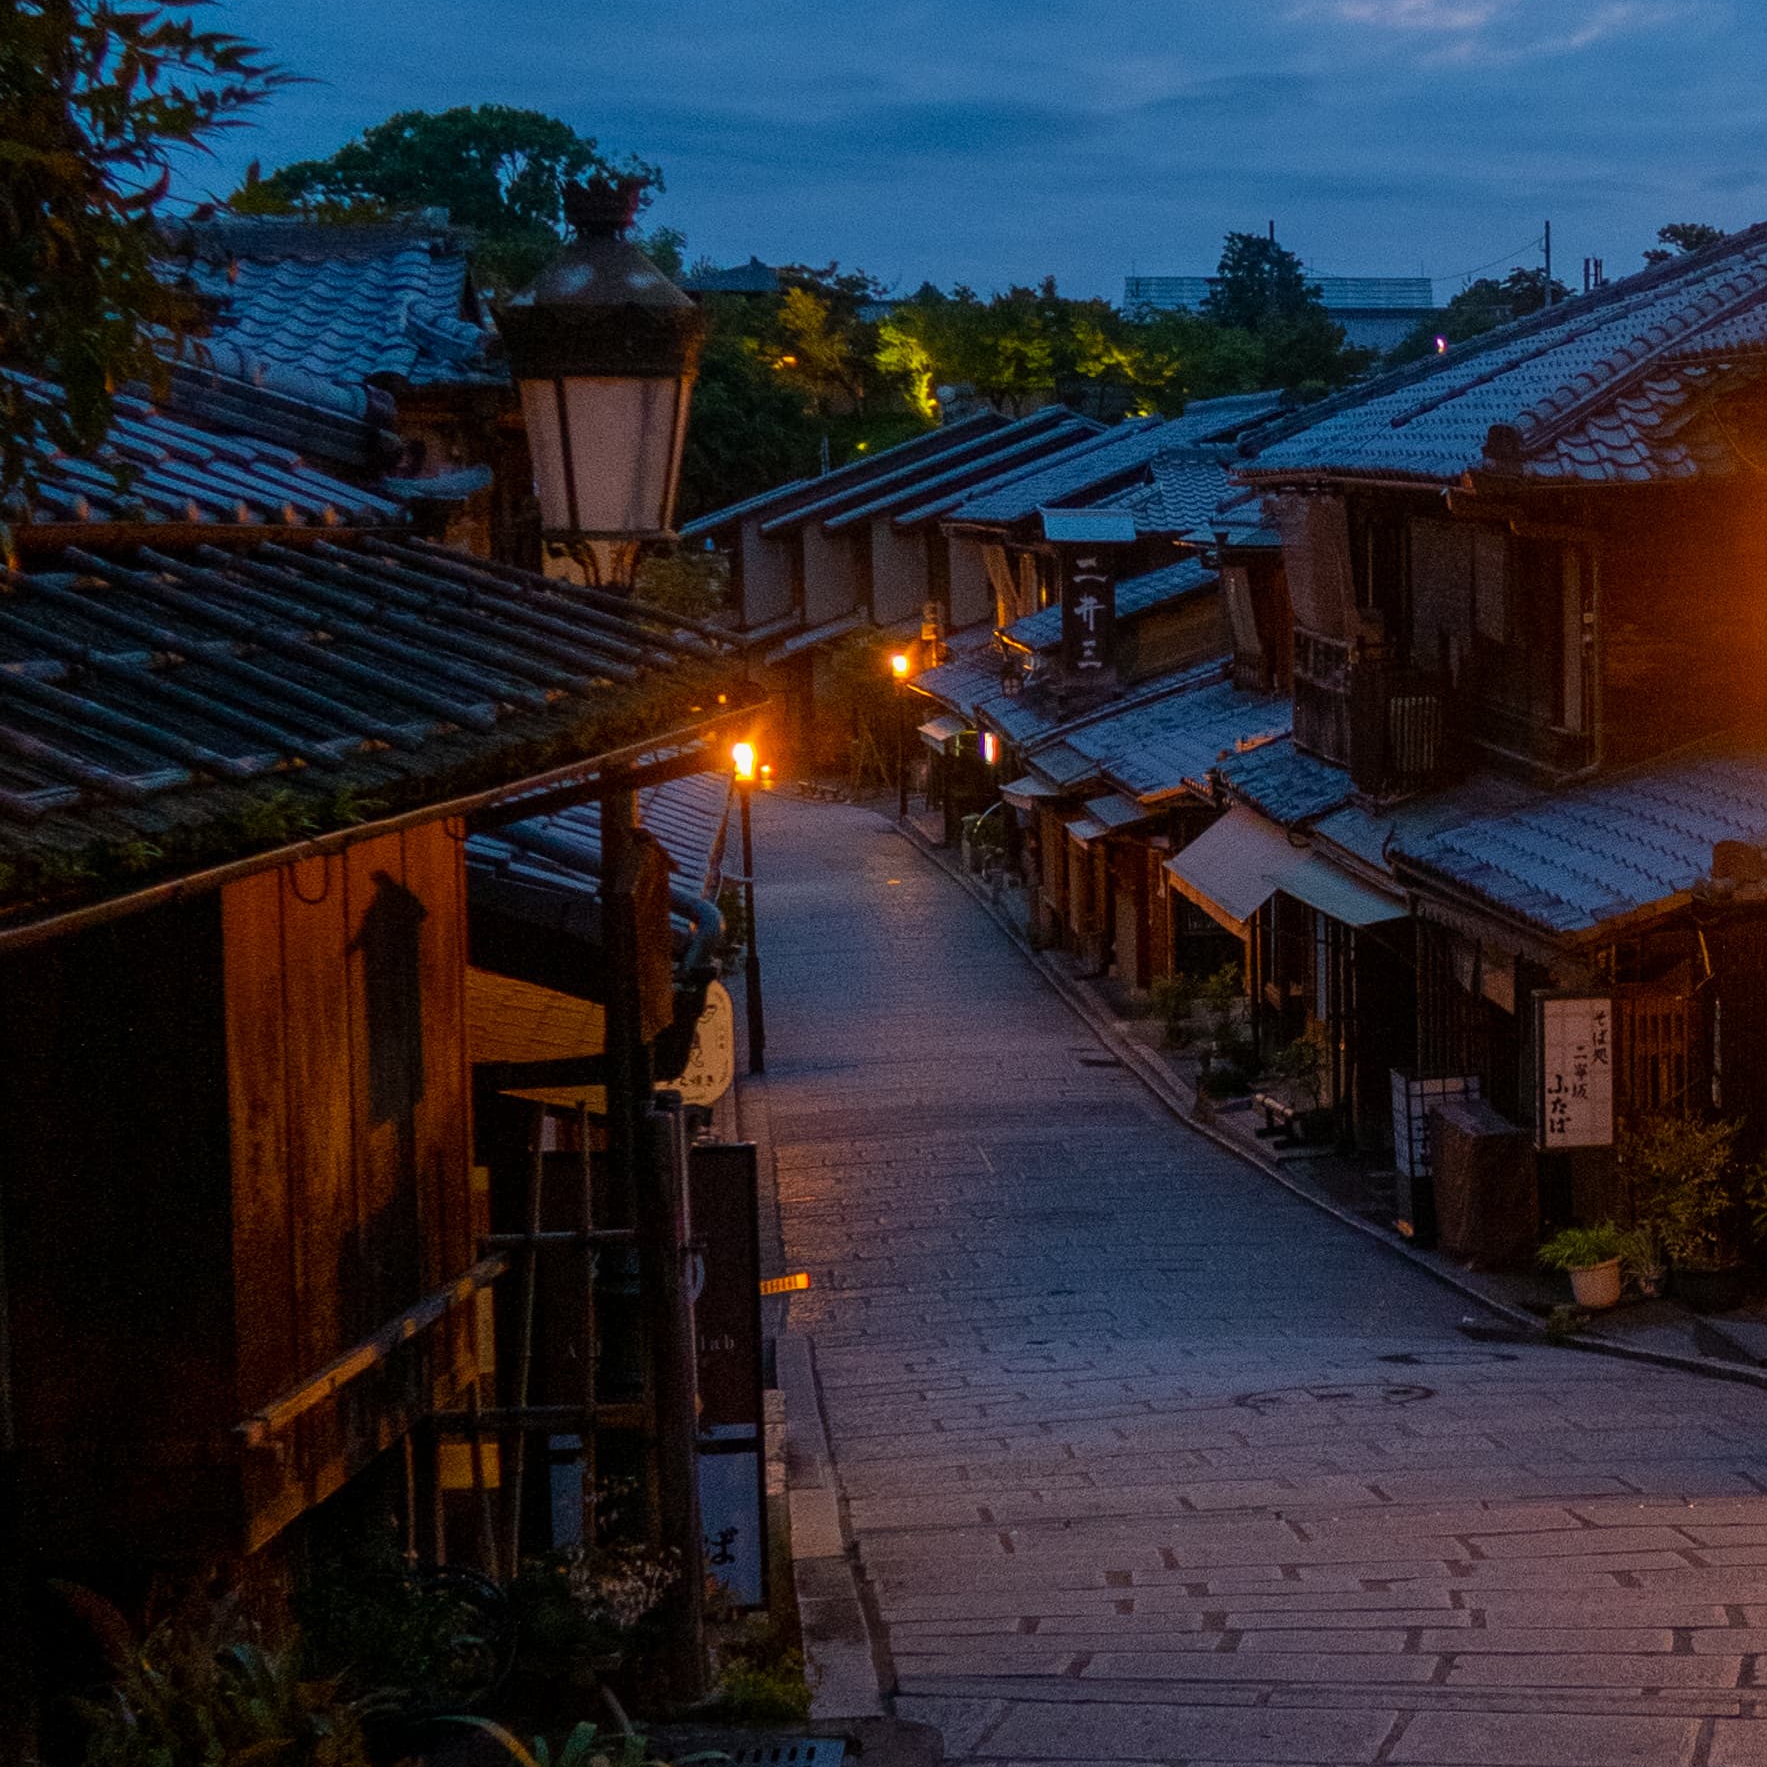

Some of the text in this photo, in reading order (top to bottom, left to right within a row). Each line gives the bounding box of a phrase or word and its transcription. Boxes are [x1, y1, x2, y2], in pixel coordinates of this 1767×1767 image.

[1071, 555, 1109, 670] 二井三
[1547, 1073, 1572, 1134] ふたば
